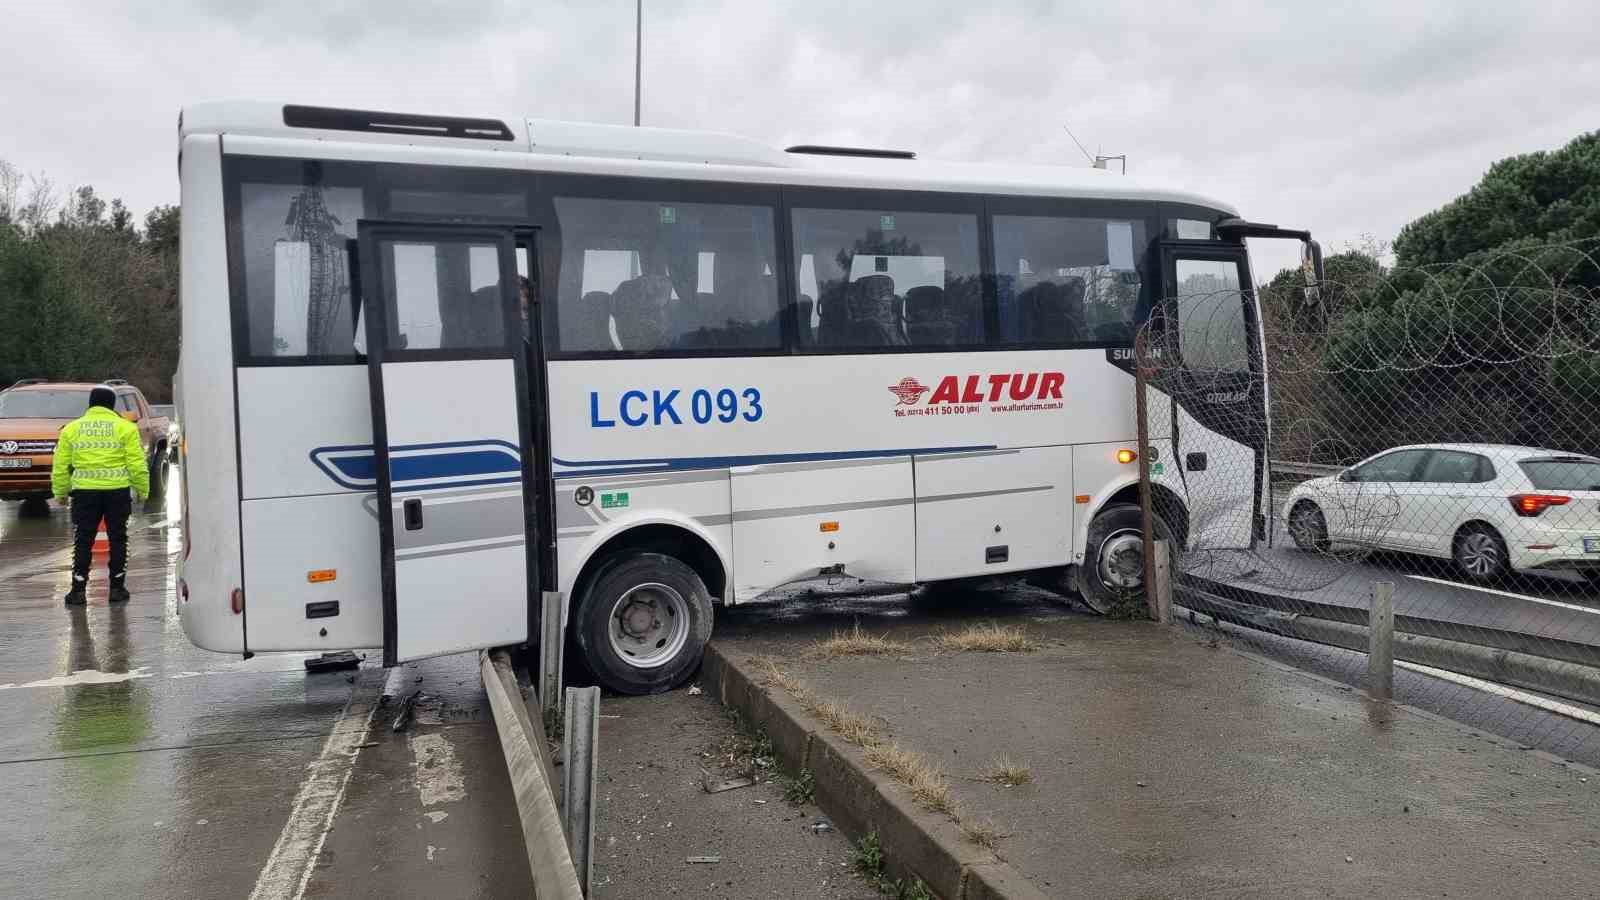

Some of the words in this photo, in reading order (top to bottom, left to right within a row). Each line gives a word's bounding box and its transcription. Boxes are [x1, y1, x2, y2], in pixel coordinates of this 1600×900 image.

[928, 372, 1065, 404] ALTUR
[590, 389, 683, 428] LCK
[691, 387, 763, 424] 093
[924, 407, 939, 416] 411
[941, 406, 952, 415] 50
[954, 405, 965, 414] 00
